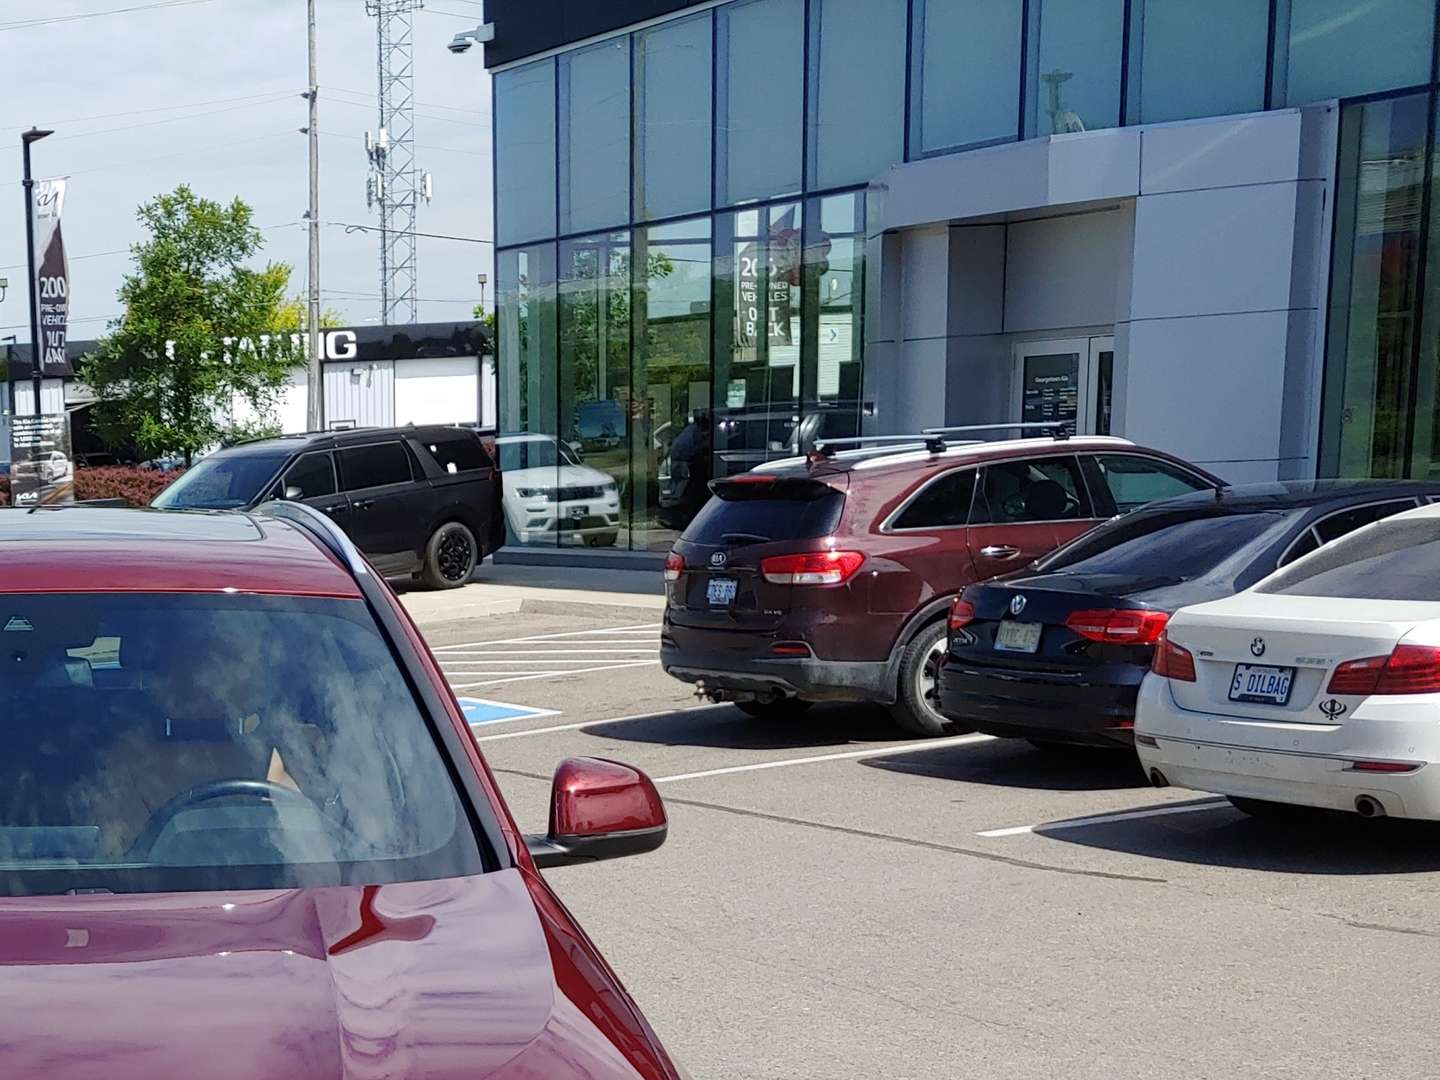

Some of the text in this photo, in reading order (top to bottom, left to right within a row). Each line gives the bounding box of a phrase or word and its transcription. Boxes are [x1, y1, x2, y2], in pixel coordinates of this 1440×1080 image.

[40, 276, 66, 298] 200
[748, 307, 779, 322] OT
[1246, 673, 1289, 696] DILBAG
